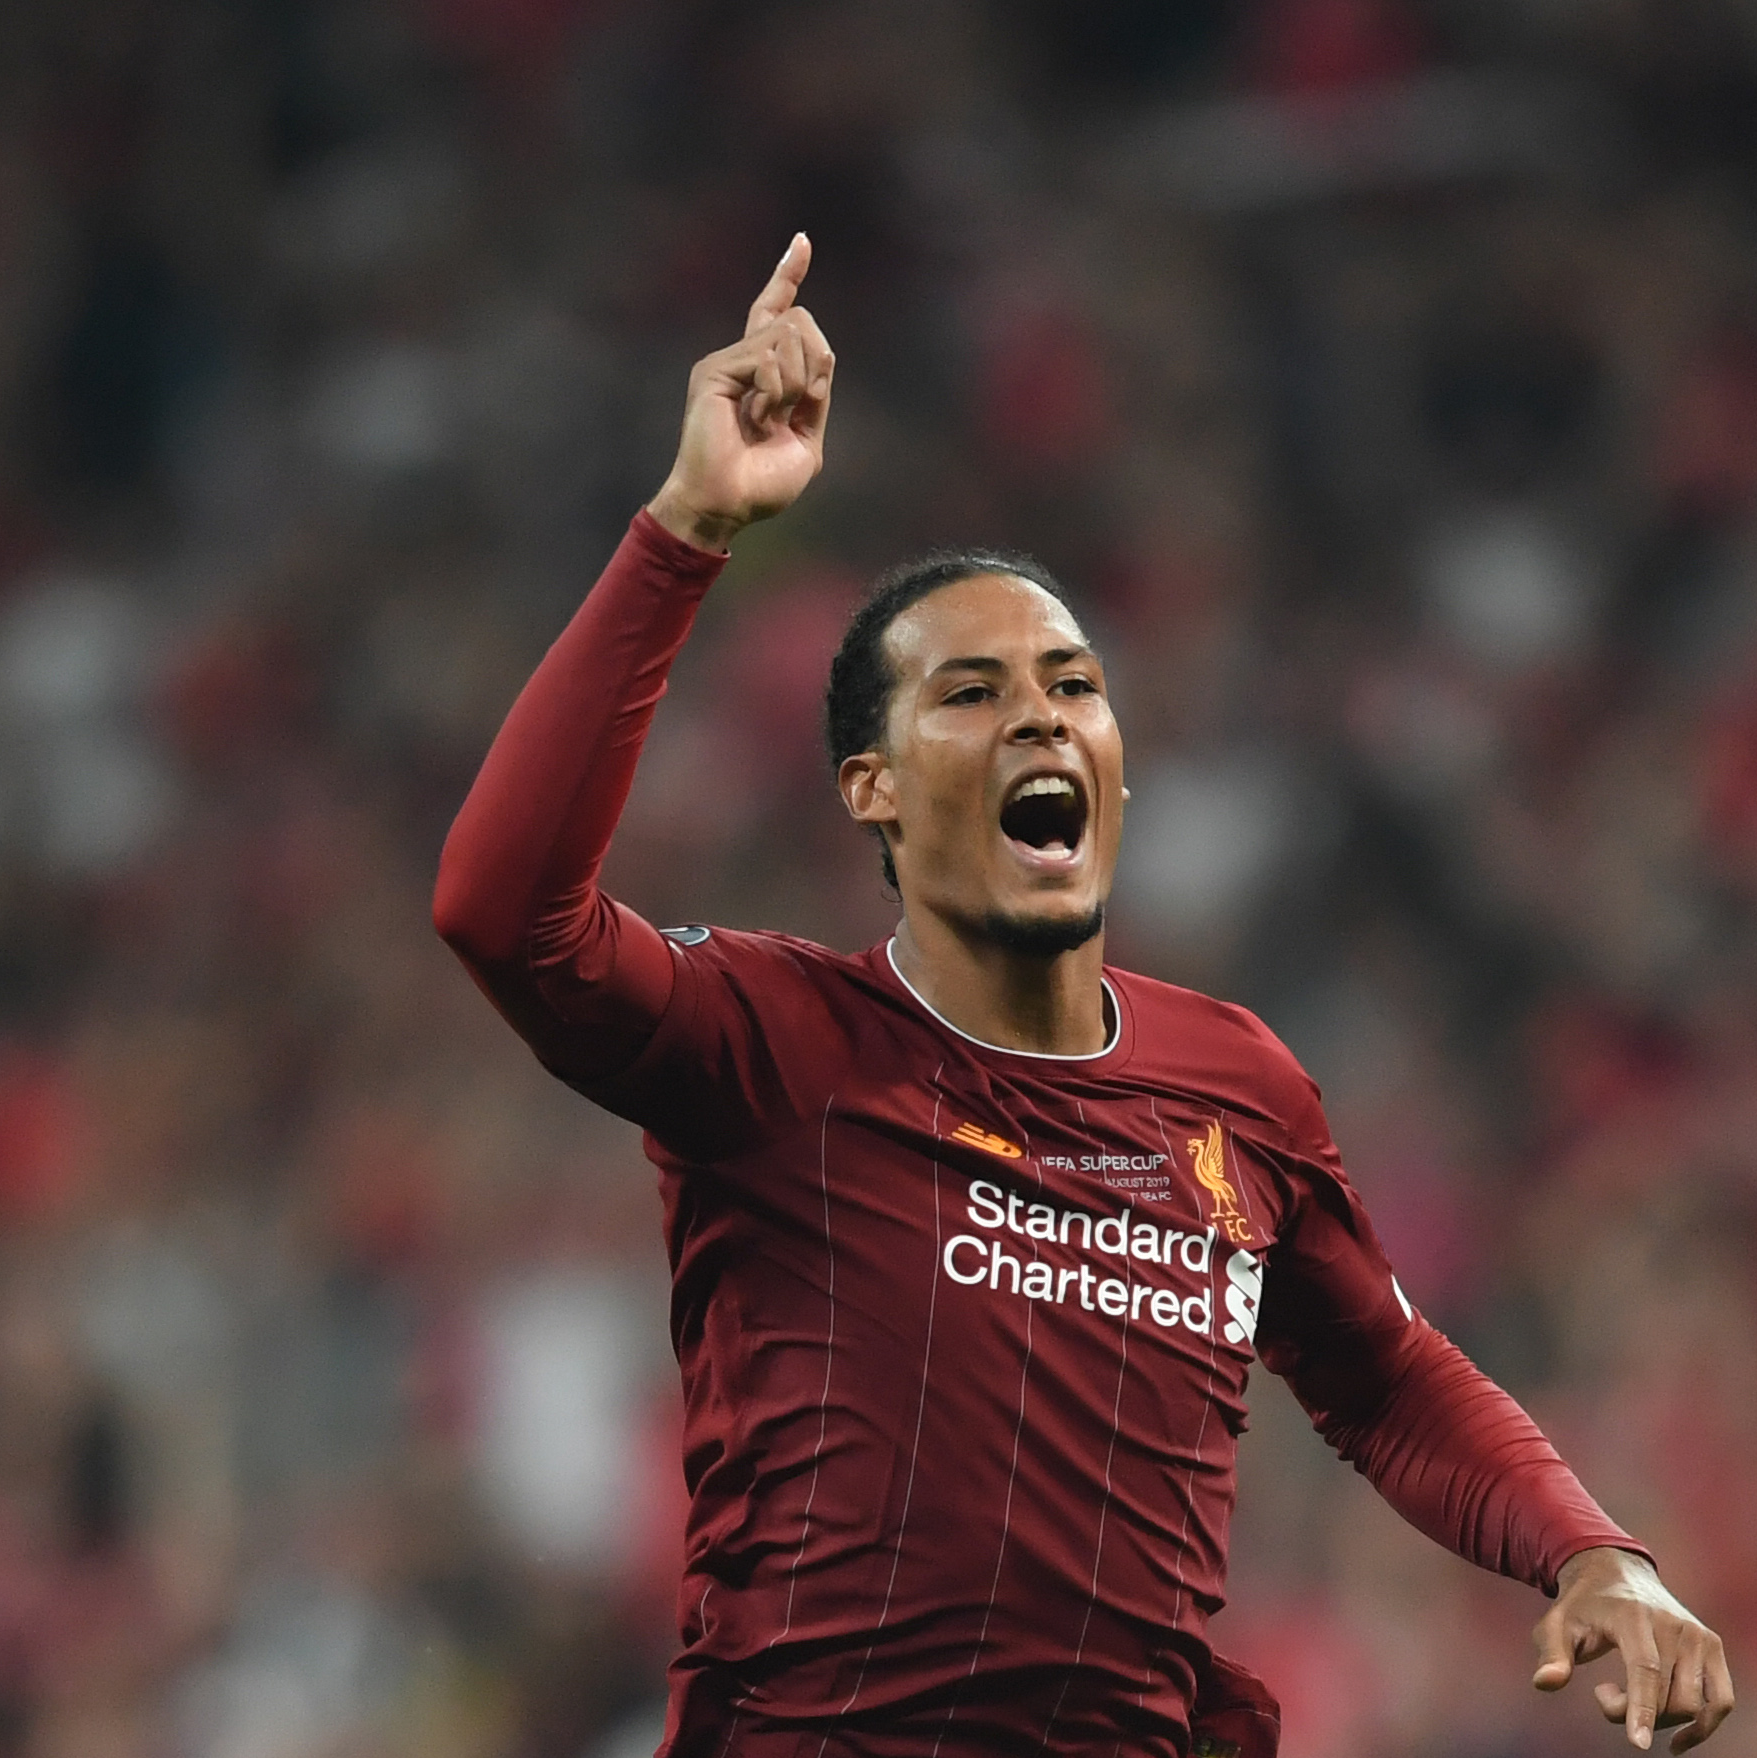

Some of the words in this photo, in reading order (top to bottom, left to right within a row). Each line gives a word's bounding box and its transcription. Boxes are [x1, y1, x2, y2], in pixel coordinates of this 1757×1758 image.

[1041, 1156, 1076, 1172] EFA
[1080, 1155, 1130, 1171] SUPER
[1146, 1176, 1171, 1188] 2019
[967, 1179, 1215, 1274] Standard
[942, 1233, 1213, 1335] Chartered
